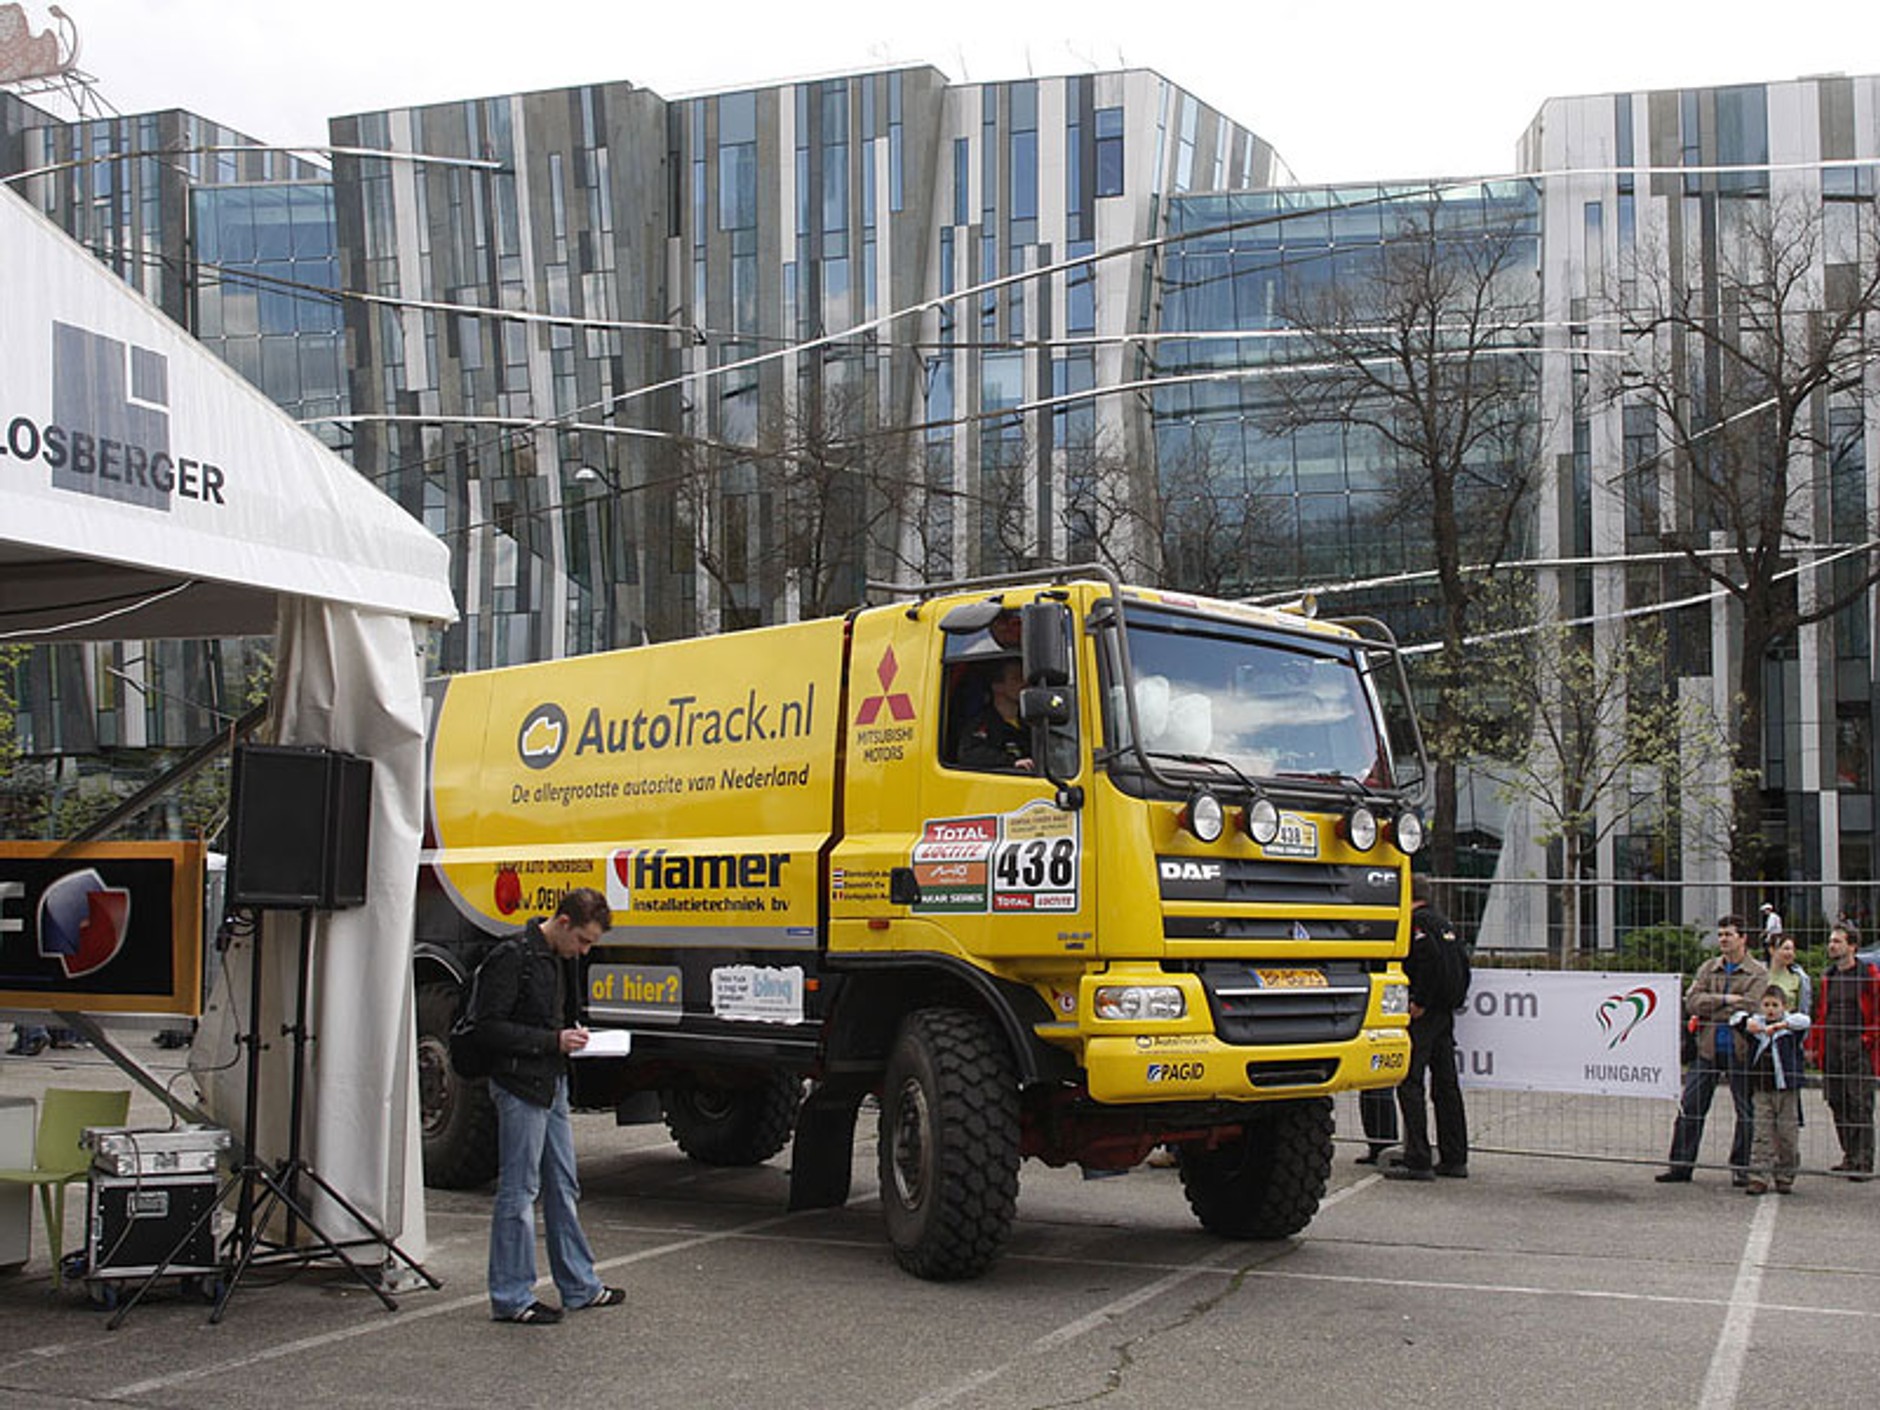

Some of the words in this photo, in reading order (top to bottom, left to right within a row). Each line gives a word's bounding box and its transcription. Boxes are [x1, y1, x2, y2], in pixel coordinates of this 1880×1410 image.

[574, 682, 815, 756] AutoTrack.nl
[857, 726, 914, 744] MITSUBISHI
[863, 745, 904, 762] MOTORS
[511, 784, 530, 803] De
[534, 781, 619, 806] allergrootste
[623, 774, 683, 796] autosite
[688, 775, 716, 791] van
[720, 763, 810, 790] Nederland
[933, 825, 989, 840] TOTAL
[634, 849, 791, 889] Hamer
[997, 838, 1075, 887] 438
[1161, 862, 1221, 880] DAF
[634, 896, 766, 911] installatietechniek
[771, 897, 790, 911] bv
[592, 974, 613, 1000] of
[623, 974, 679, 1003] hier?
[1161, 1063, 1205, 1081] PAGID
[1584, 1064, 1663, 1084] HUNGARY
